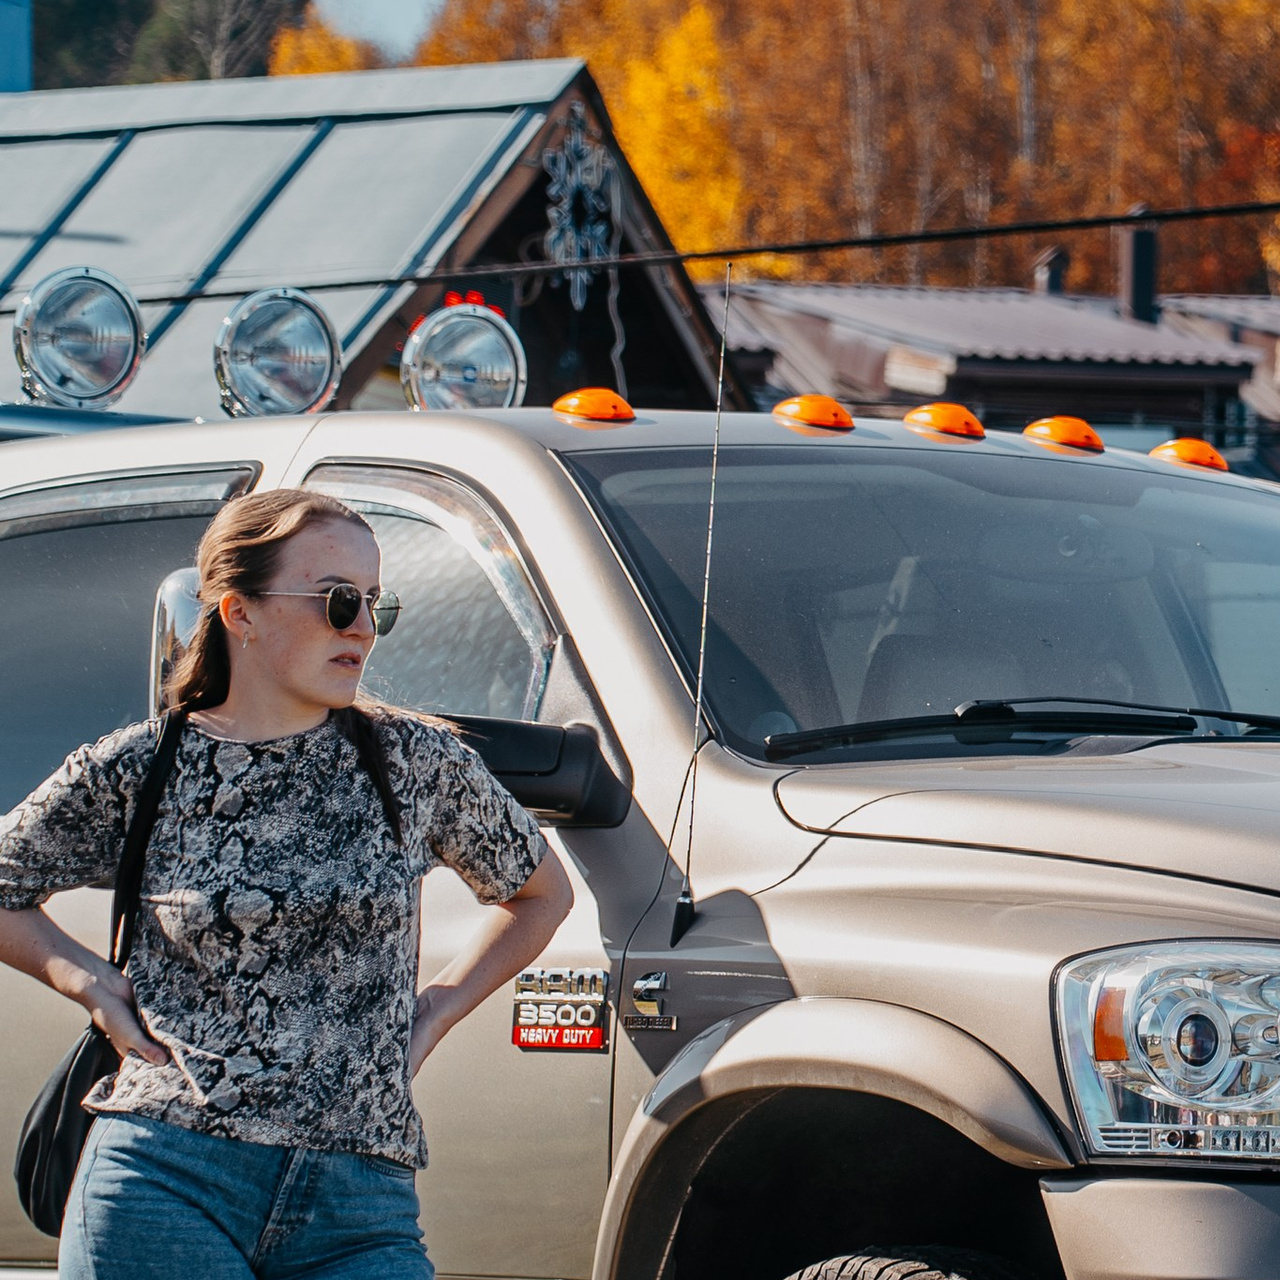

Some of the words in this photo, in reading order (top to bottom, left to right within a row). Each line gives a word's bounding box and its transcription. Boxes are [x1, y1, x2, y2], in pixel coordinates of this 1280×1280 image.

[518, 1003, 596, 1026] 3500
[520, 1028, 559, 1044] HEAVY
[562, 1029, 593, 1044] DUTY
